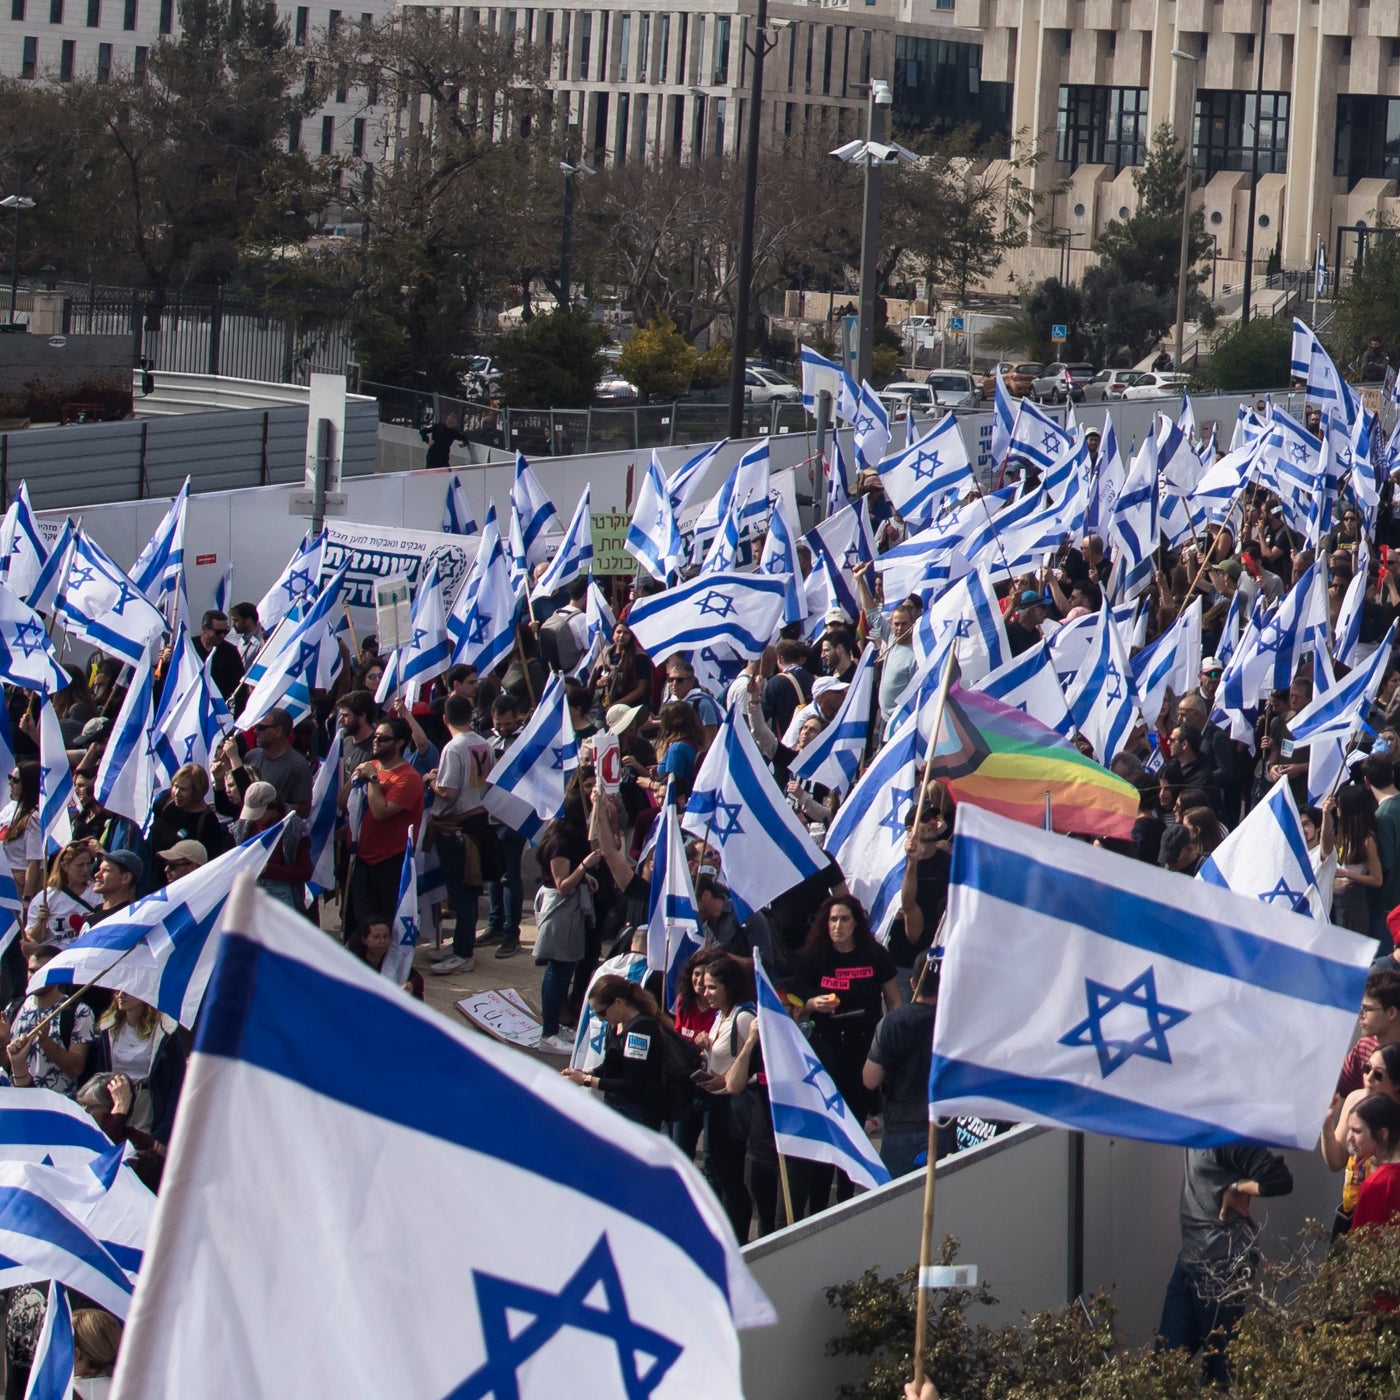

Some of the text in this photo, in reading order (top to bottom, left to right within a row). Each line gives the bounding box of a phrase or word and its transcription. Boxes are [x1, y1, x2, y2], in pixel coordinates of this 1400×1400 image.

[349, 534, 368, 544] למען
[370, 537, 399, 549] ונאבקות
[400, 540, 427, 551] נאבקים
